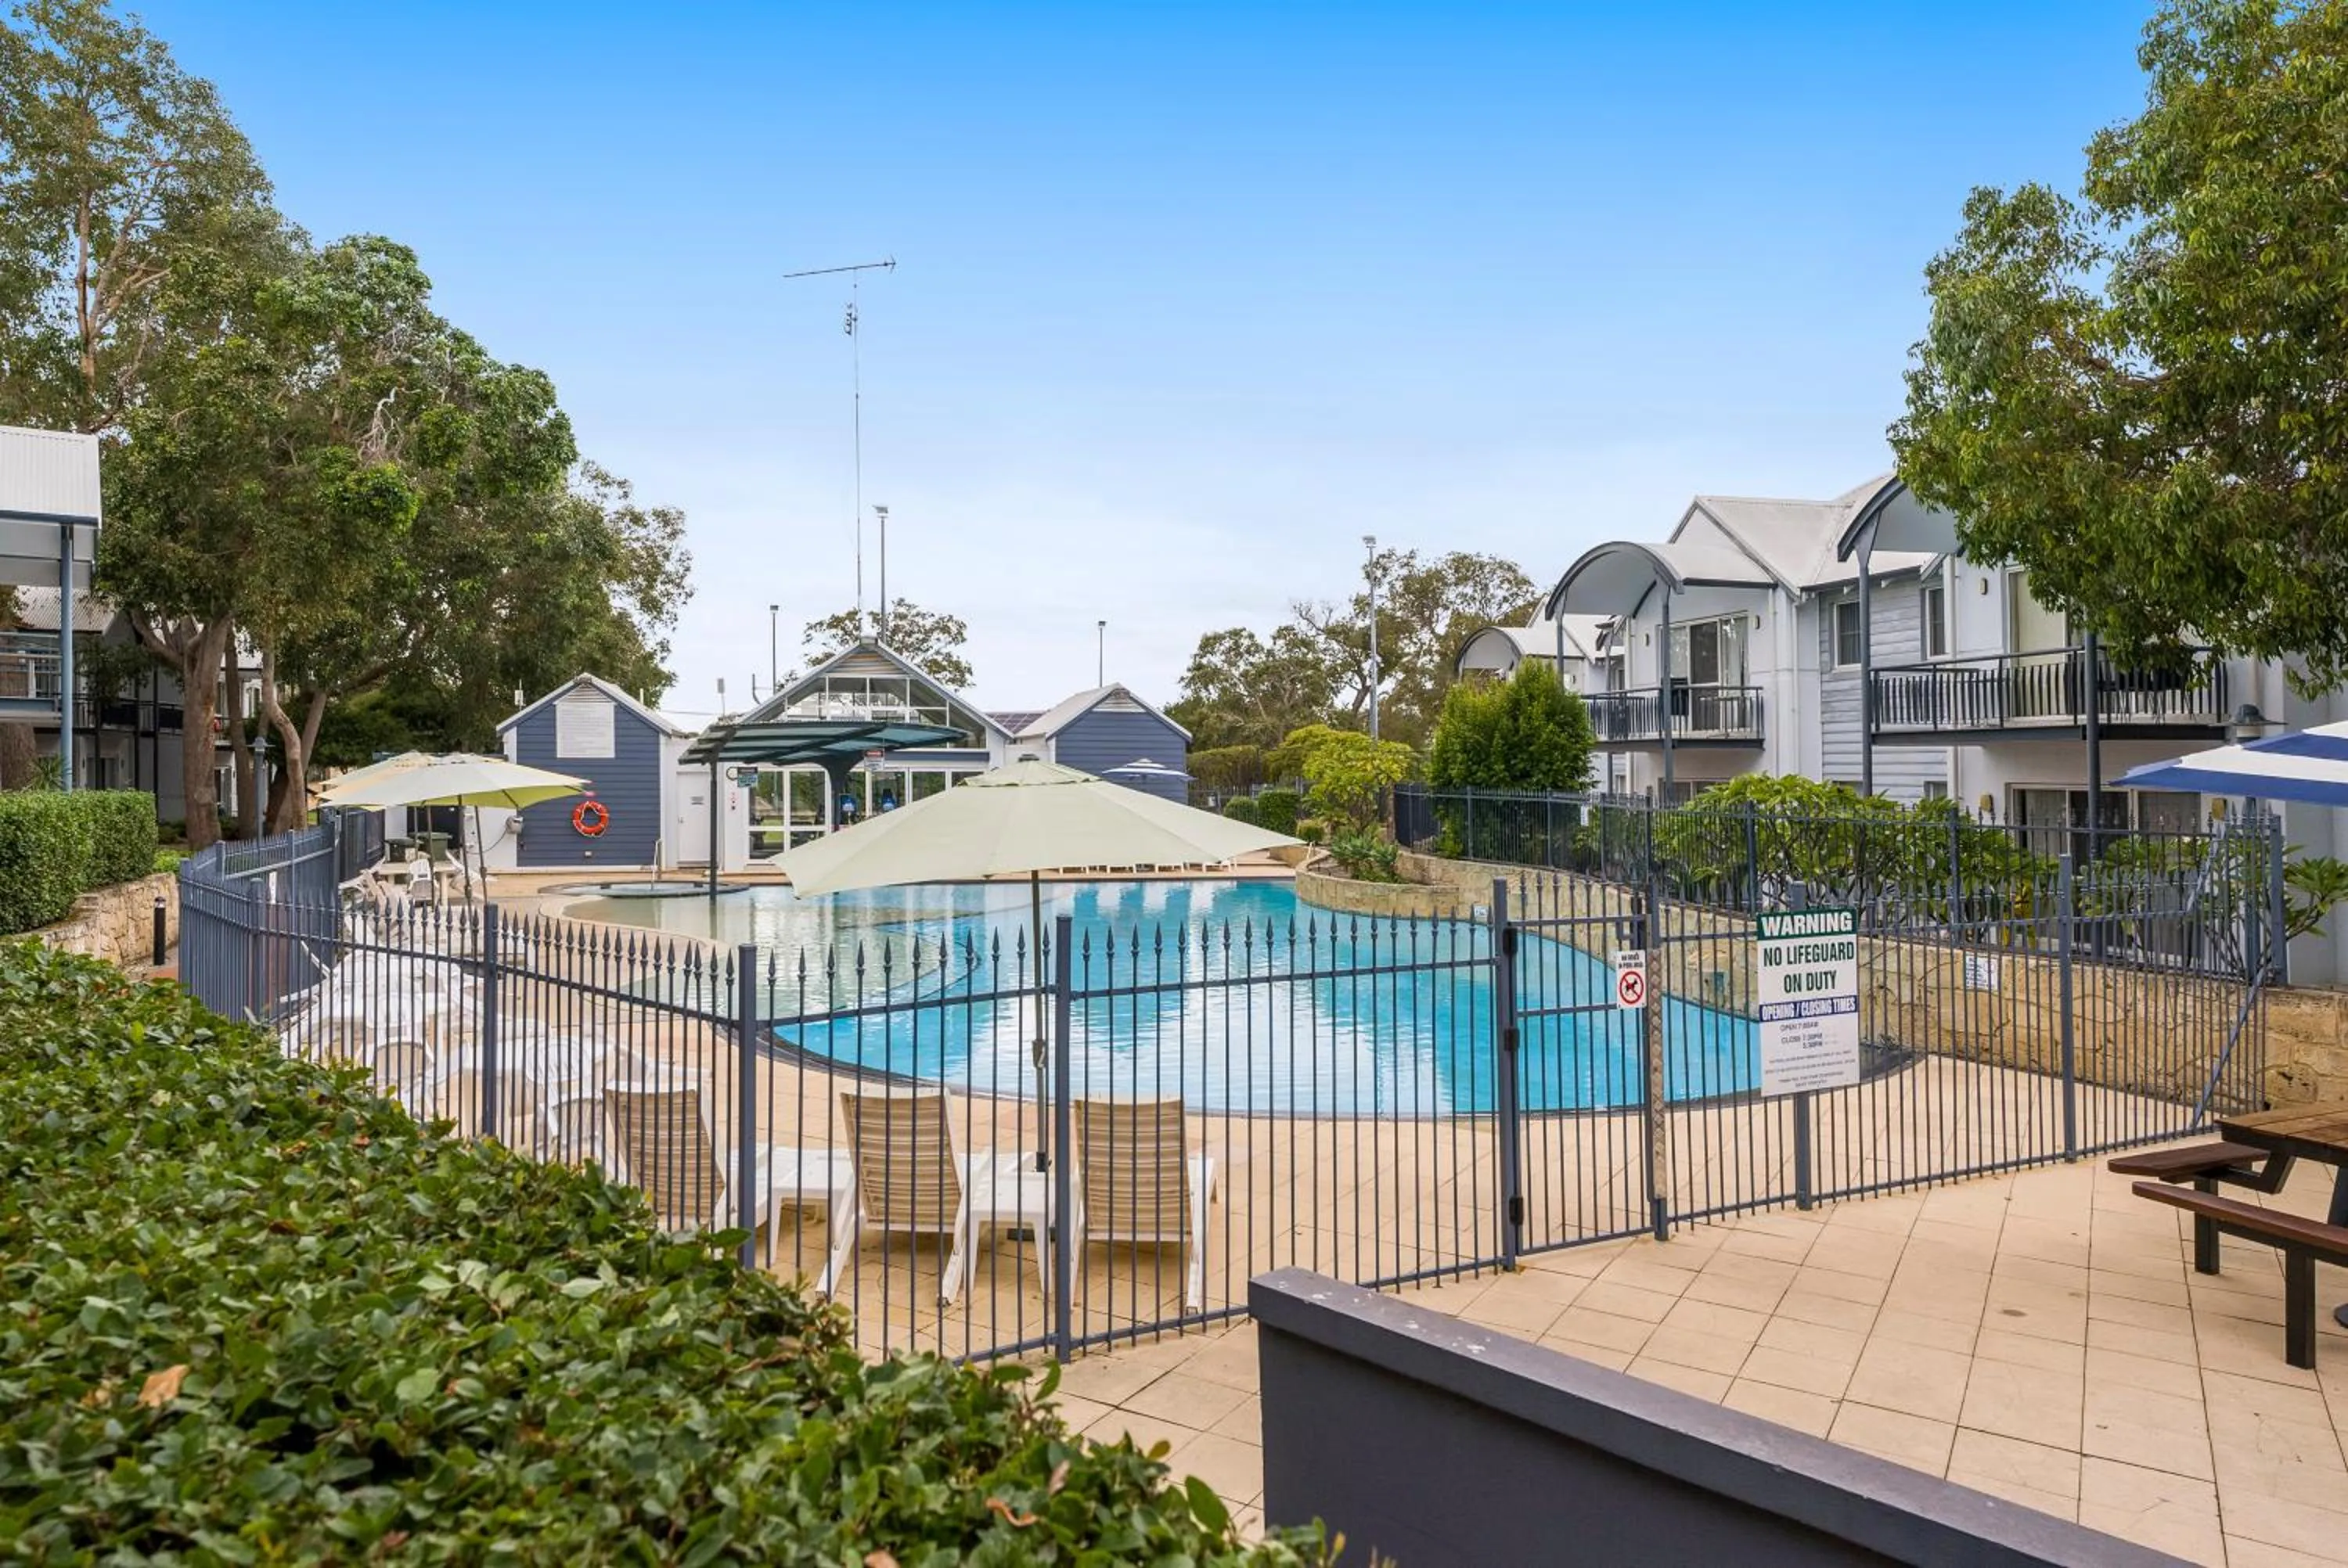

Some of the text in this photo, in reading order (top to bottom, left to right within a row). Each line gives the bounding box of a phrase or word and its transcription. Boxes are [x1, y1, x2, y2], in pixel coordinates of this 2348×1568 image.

[1761, 912, 1853, 937] WARNING
[1763, 941, 1854, 967] NO LIFEGUARD
[1784, 969, 1837, 994] ON DUTY
[1762, 1002, 1795, 1020] OPENING
[1801, 998, 1831, 1016] CLOSING
[1832, 996, 1856, 1012] TIMES
